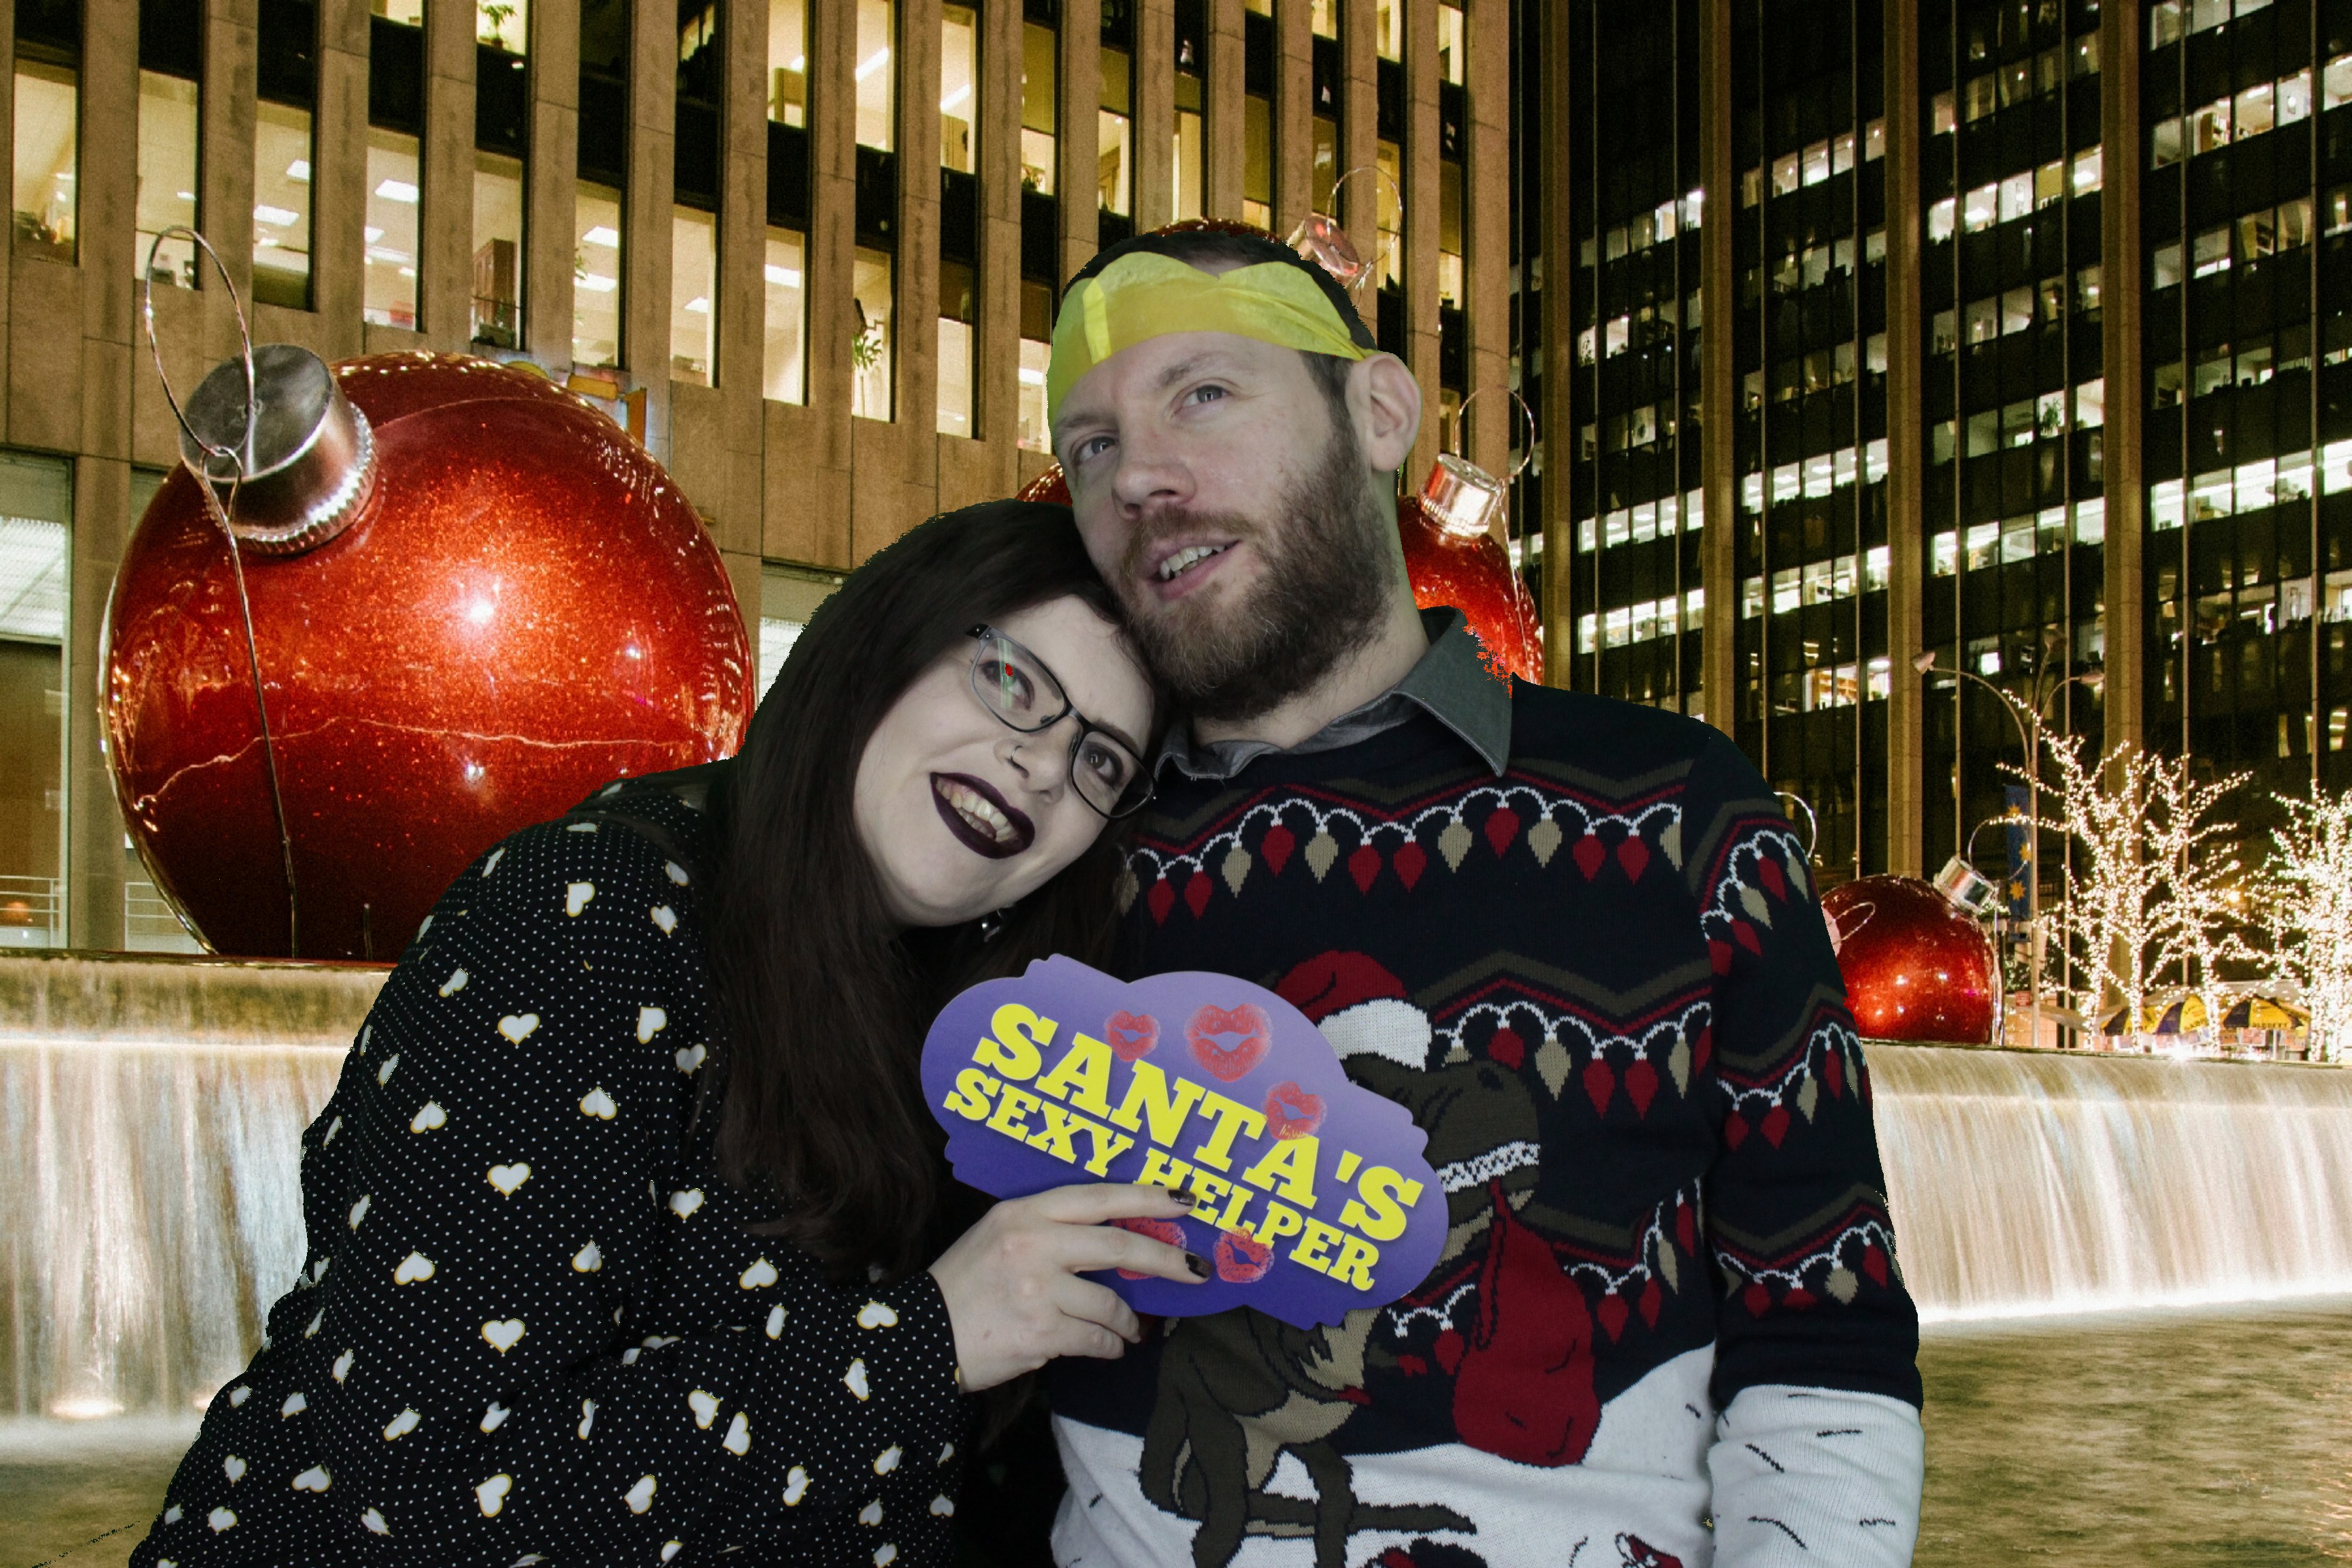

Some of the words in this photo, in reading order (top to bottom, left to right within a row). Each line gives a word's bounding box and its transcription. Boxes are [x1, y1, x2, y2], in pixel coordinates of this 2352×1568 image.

[943, 1068, 1134, 1177] SEXY
[1132, 1147, 1380, 1290] HELPER
[973, 1004, 1424, 1241] SANTA'S
